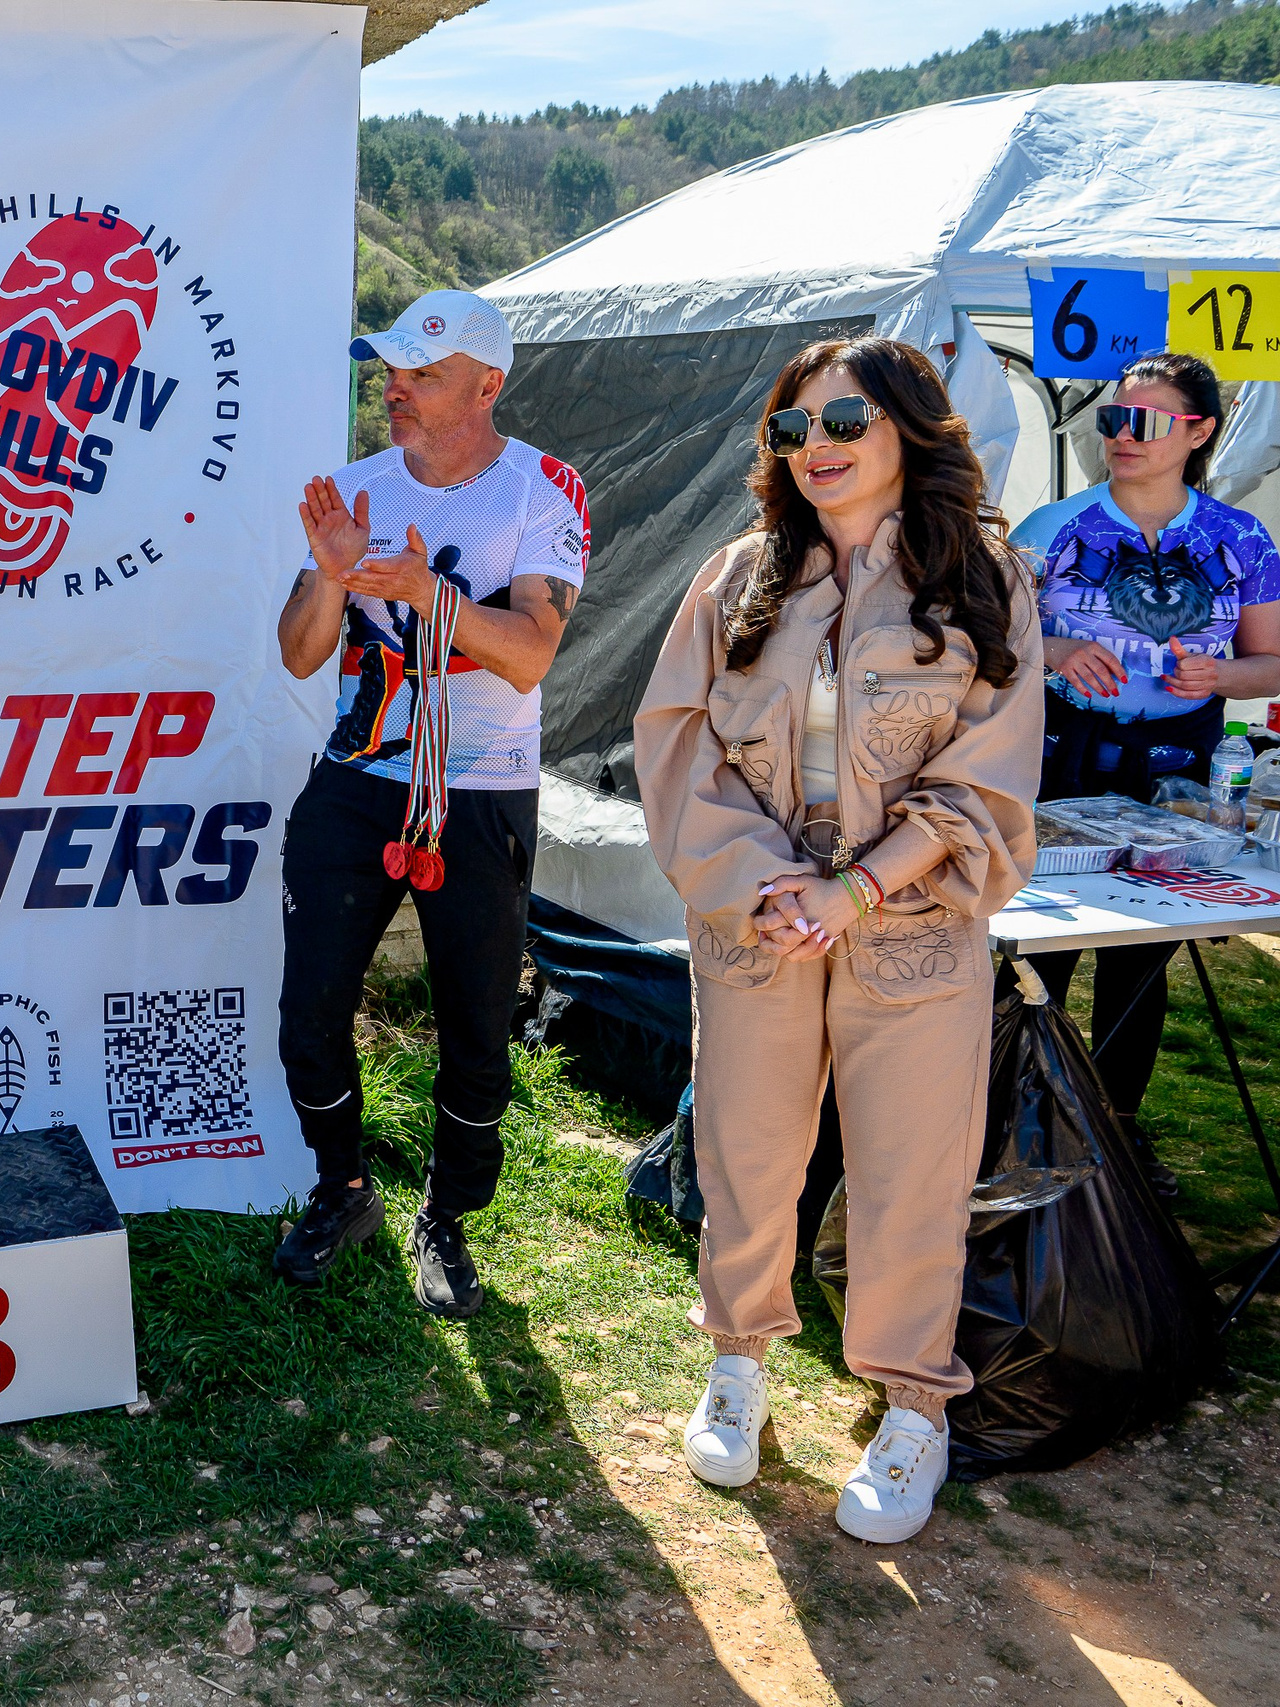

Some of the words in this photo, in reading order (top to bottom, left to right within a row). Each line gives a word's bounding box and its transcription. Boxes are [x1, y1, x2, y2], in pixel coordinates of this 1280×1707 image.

[1051, 279, 1098, 362] 6
[1110, 334, 1139, 354] KM
[1187, 283, 1254, 352] 12
[140, 224, 181, 266] IN
[183, 274, 241, 482] MARKOVO
[63, 537, 163, 598] RACE
[1107, 894, 1218, 909] TRAIL
[46, 1029, 62, 1086] FISH
[50, 1110, 64, 1118] 20
[118, 1145, 189, 1166] DON'T
[194, 1139, 260, 1156] SCAN
